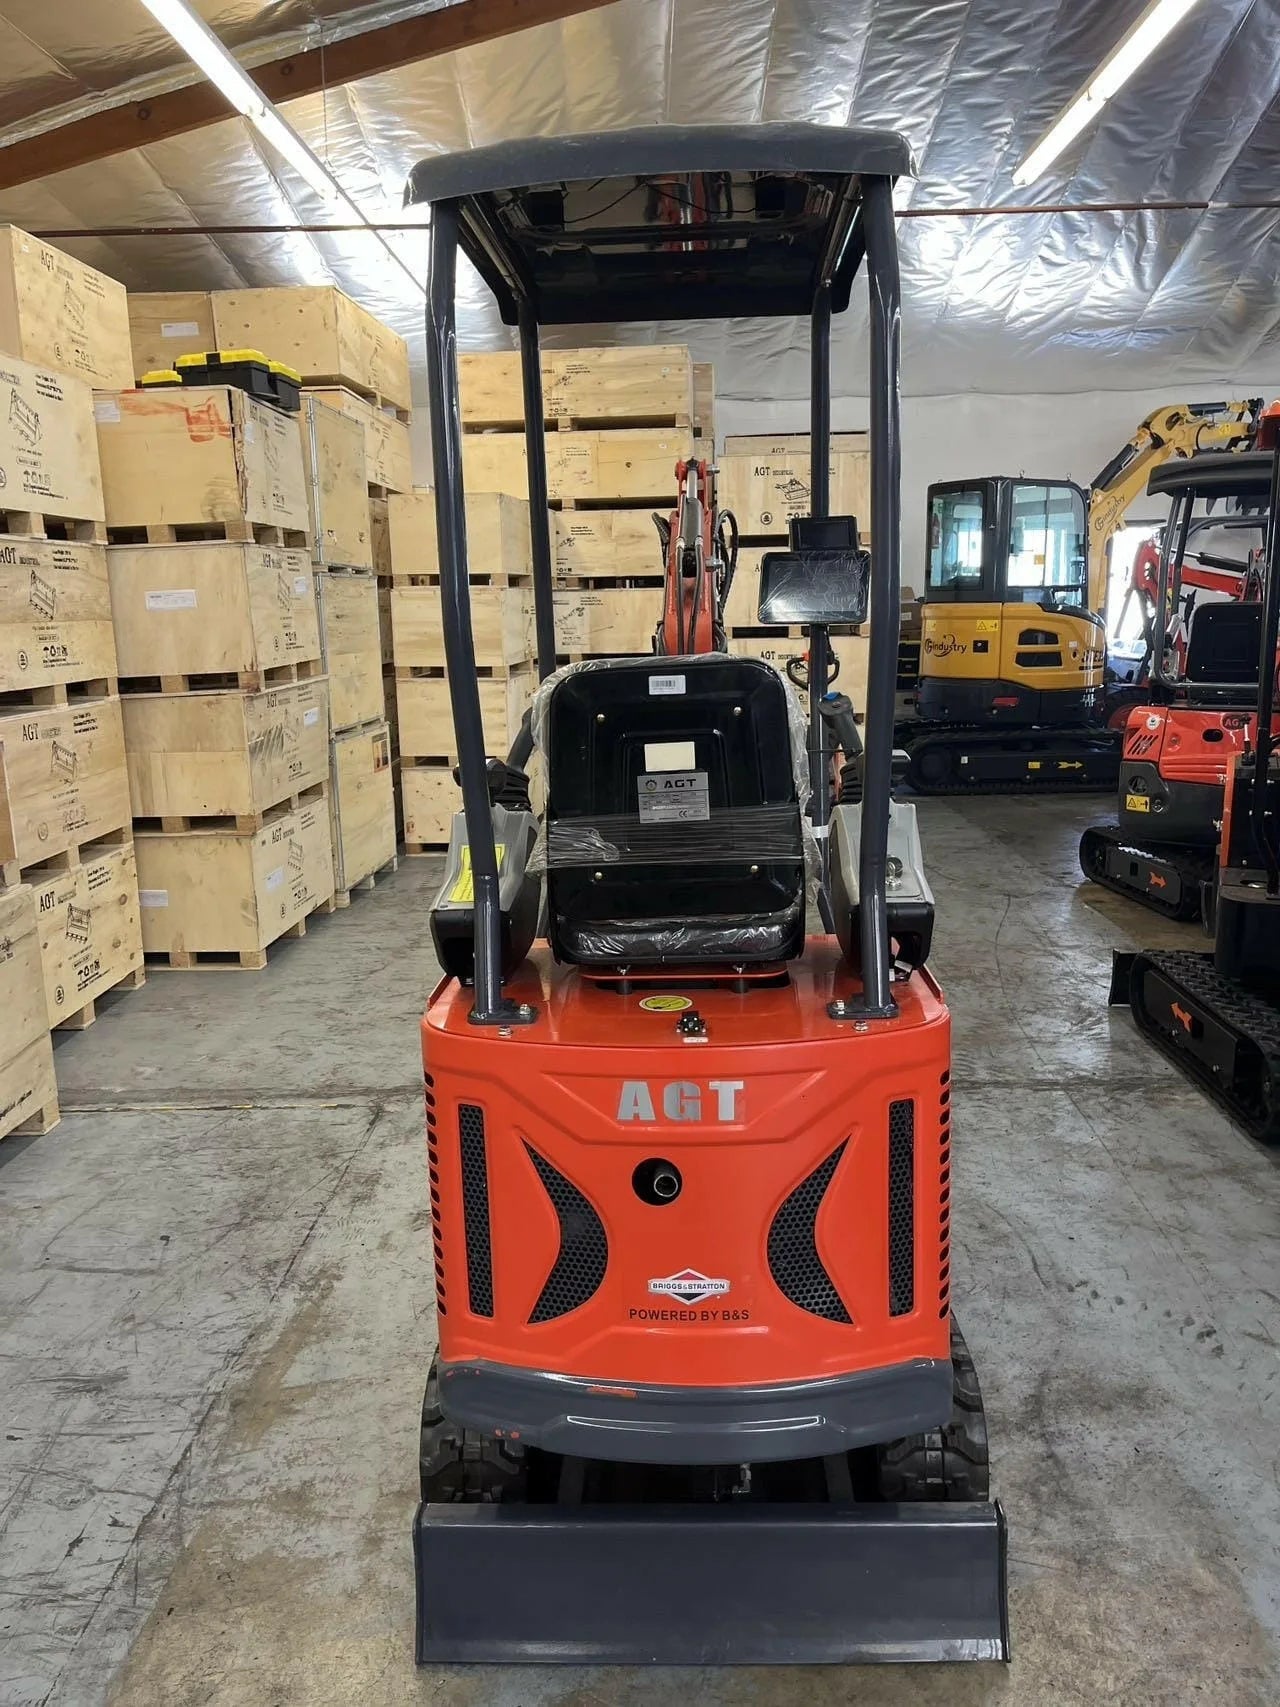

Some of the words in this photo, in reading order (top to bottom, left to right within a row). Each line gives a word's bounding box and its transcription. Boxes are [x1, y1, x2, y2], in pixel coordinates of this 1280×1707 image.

[754, 467, 770, 476] AGT
[761, 651, 775, 660] AGT
[22, 722, 39, 742] AGT
[664, 779, 697, 788] AGT
[40, 891, 56, 912] AGT
[617, 1080, 744, 1121] AGT
[629, 1308, 697, 1321] POWERED
[701, 1310, 719, 1321] BY
[722, 1310, 749, 1320] B&S
